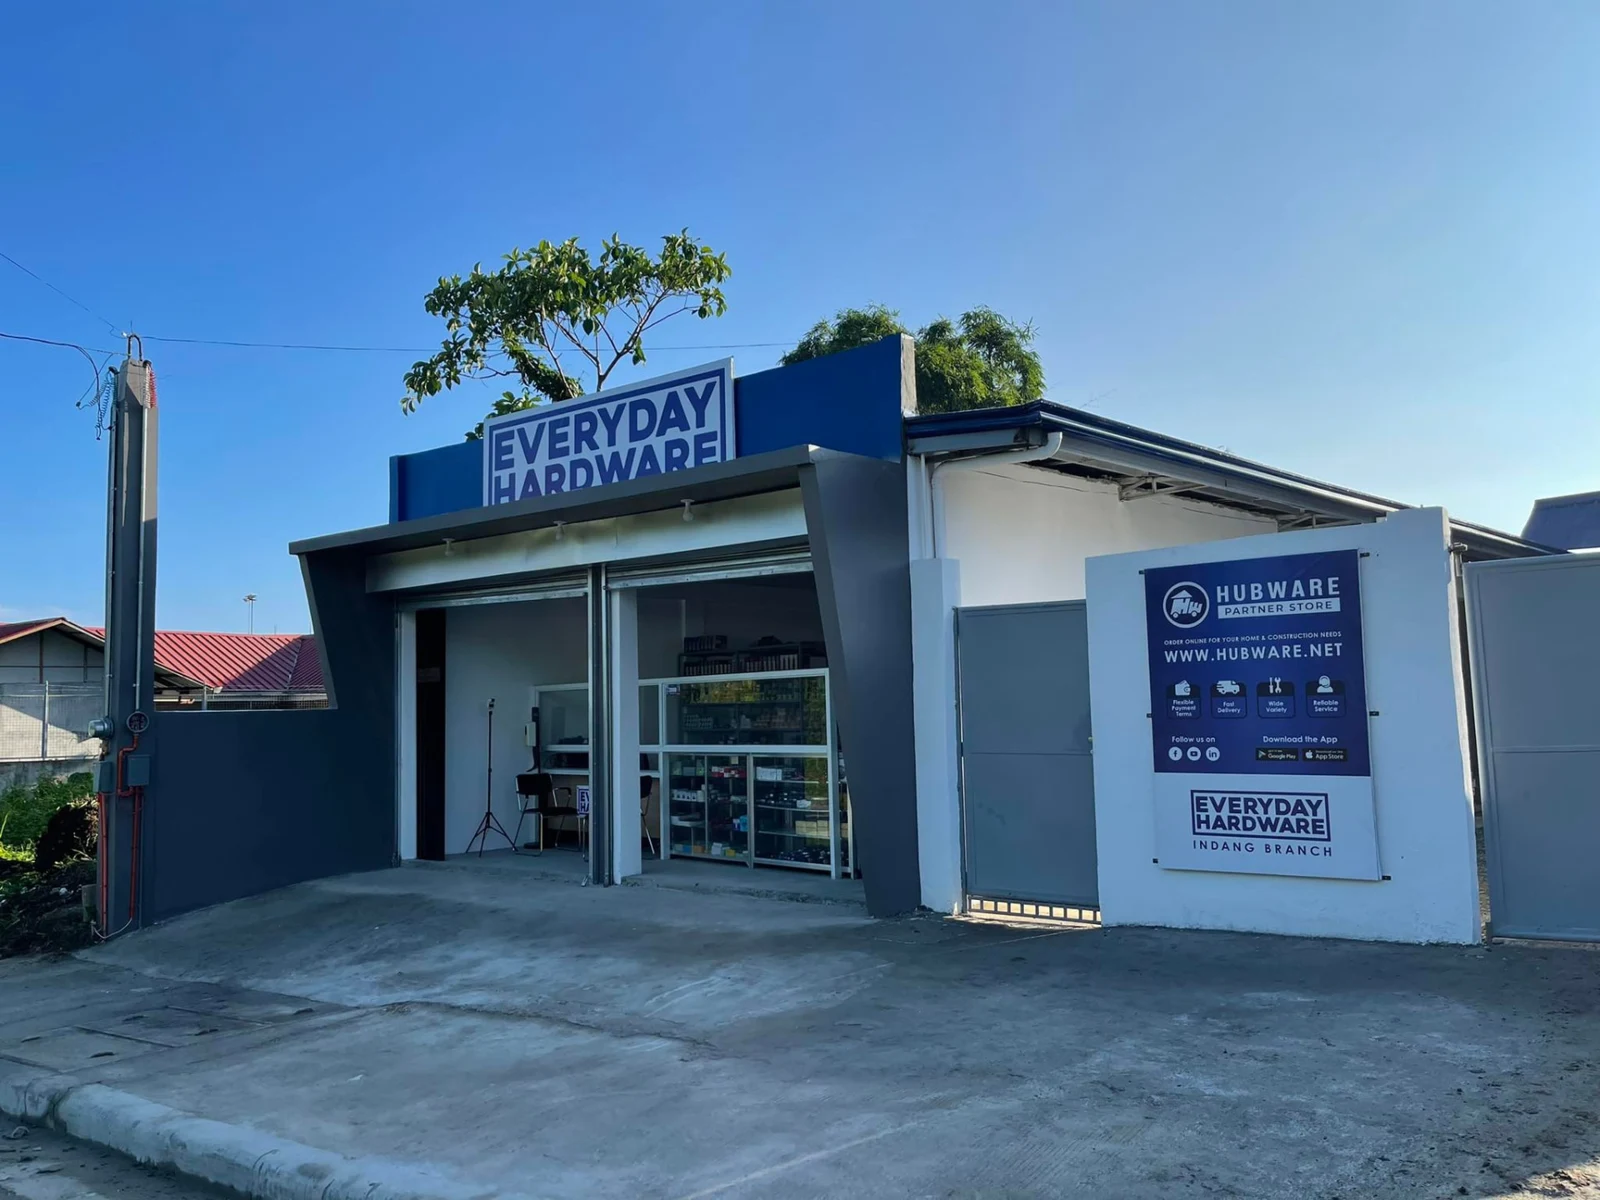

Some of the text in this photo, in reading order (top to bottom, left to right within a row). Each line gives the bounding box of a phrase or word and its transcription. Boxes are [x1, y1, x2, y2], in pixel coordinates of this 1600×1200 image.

[494, 380, 718, 472] EVERYDAY
[494, 430, 718, 505] HARDWARE
[1216, 576, 1340, 603] HUBWARE
[1224, 600, 1333, 616] PARTNER STORE
[1184, 637, 1207, 645] ONLINE
[1267, 632, 1319, 641] CONSTRUCTION
[1164, 642, 1343, 663] WWW.HUBWARE.NET
[1262, 735, 1338, 744] Download the App
[1195, 796, 1323, 817] EVERYDAY
[1196, 814, 1325, 835] HARDWARE
[1193, 839, 1255, 853] INDANG
[1265, 843, 1332, 857] BRANCH
